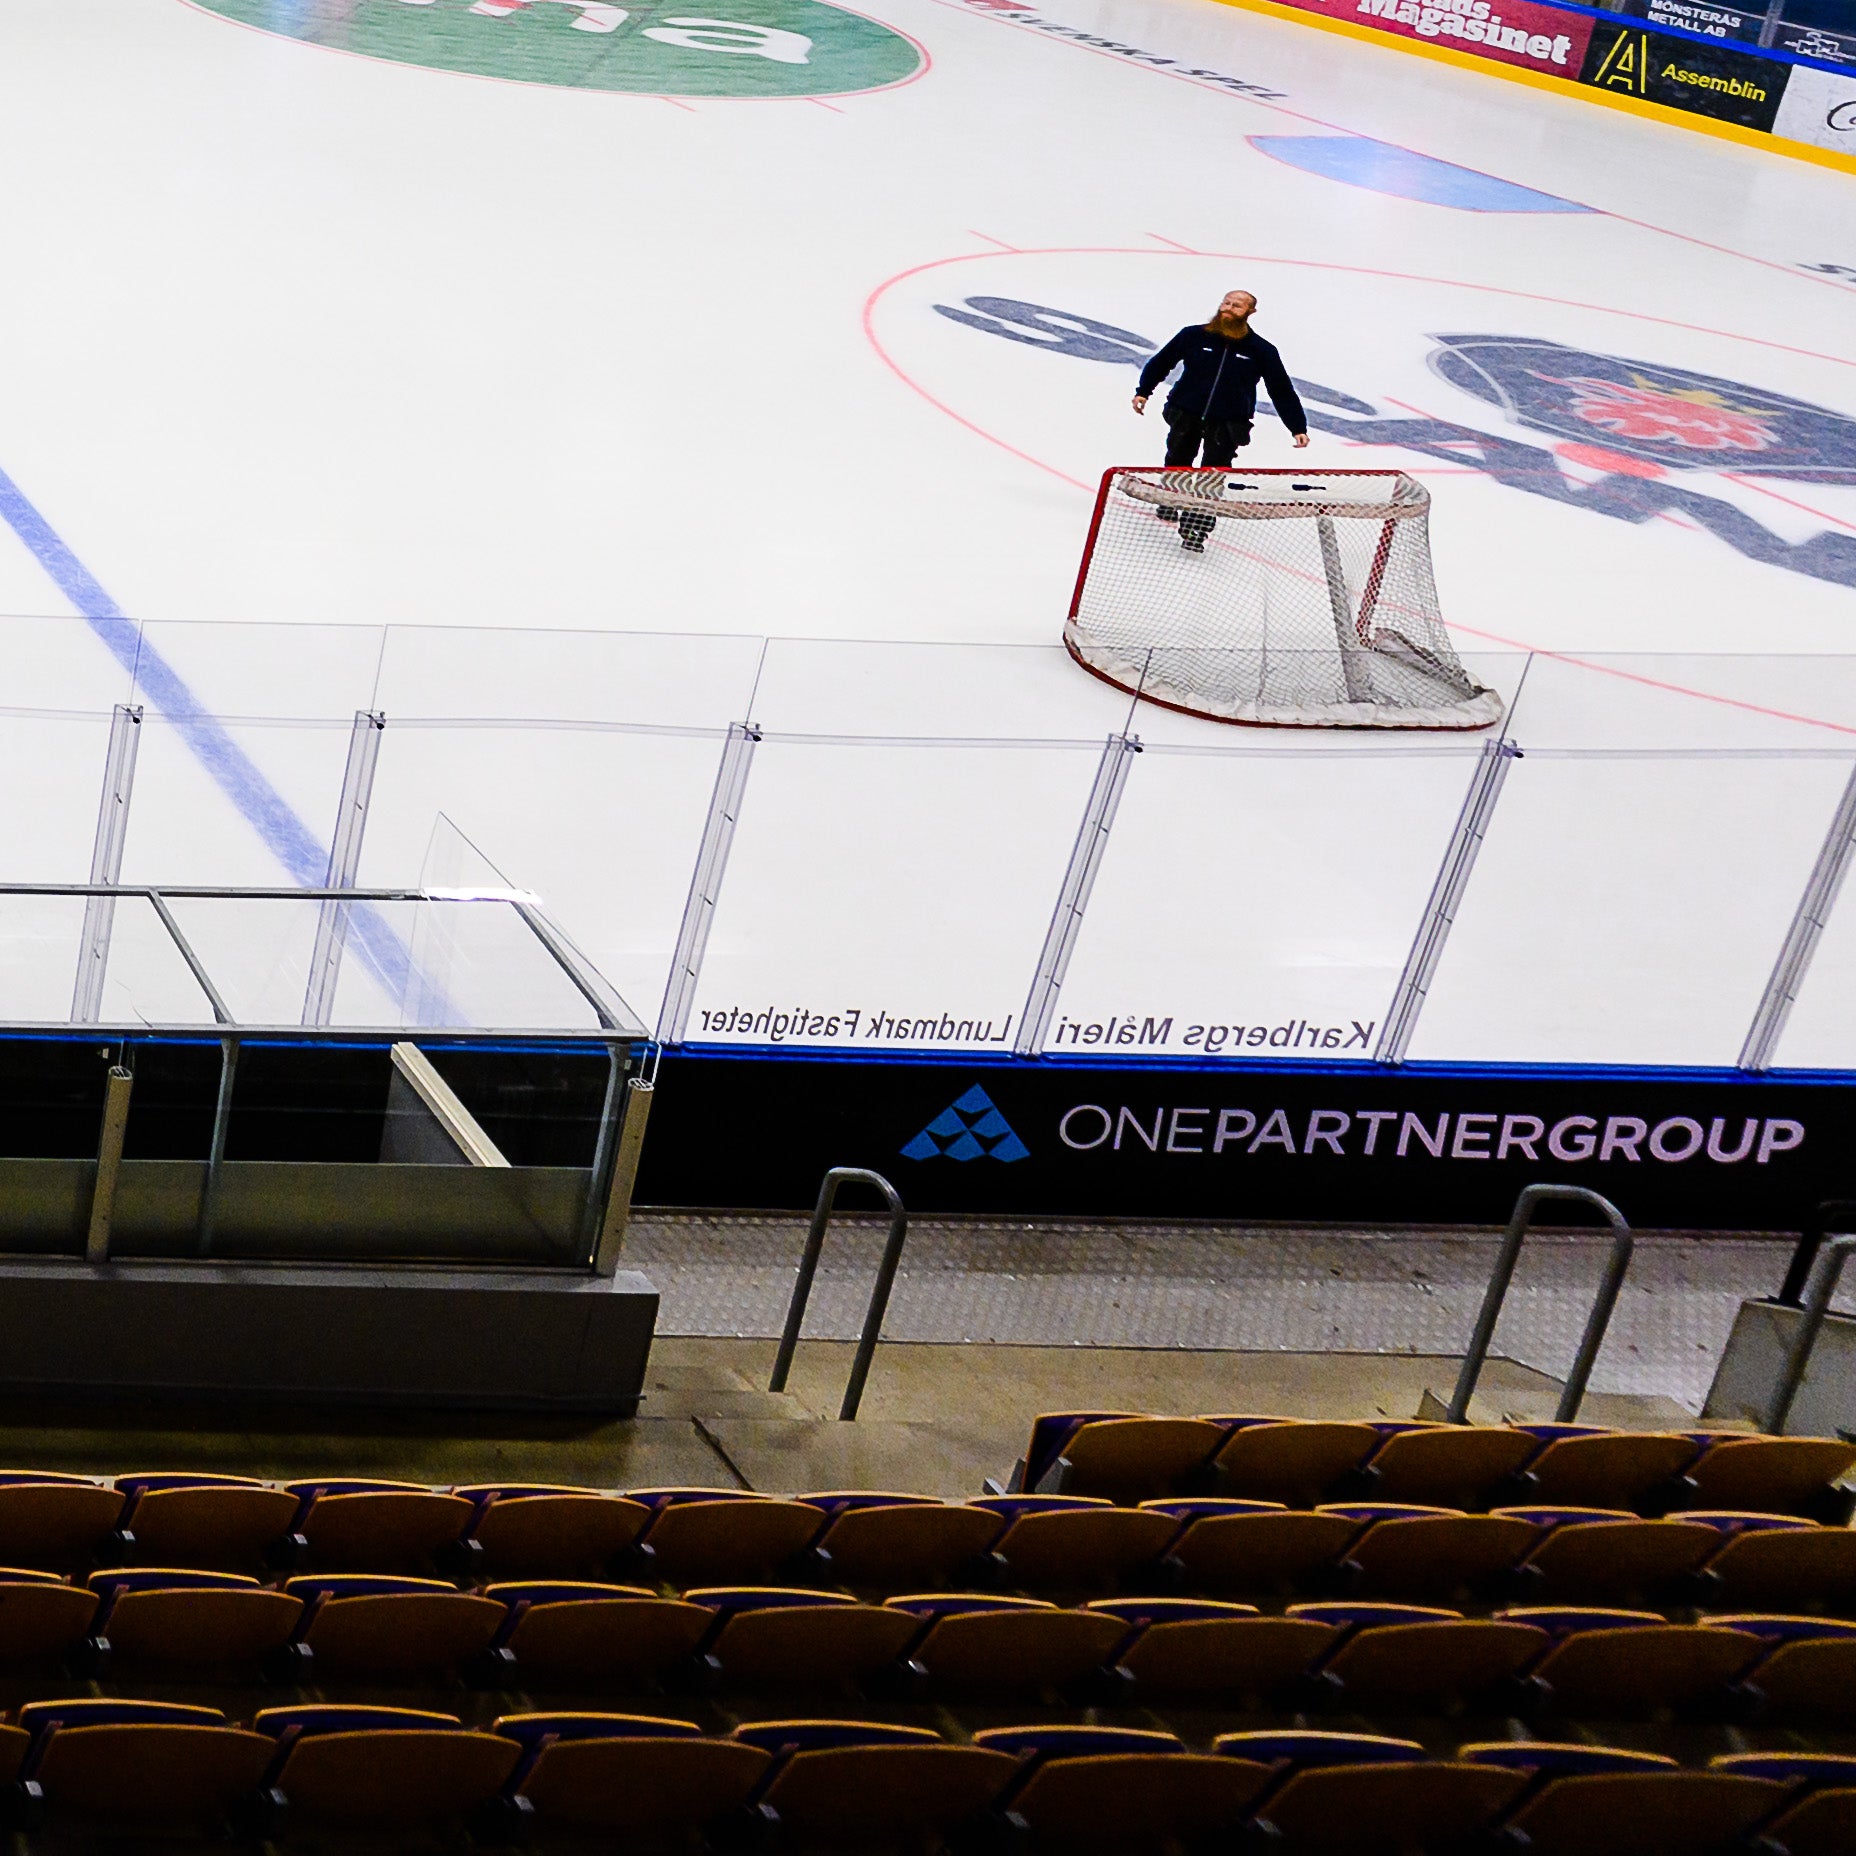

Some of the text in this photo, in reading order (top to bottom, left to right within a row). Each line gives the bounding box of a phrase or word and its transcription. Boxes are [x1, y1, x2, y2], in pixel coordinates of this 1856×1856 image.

[1648, 10, 1728, 39] METALL AB
[1661, 62, 1768, 103] Assemblin
[1058, 1102, 1806, 1165] ONEPARTNERGROUP
